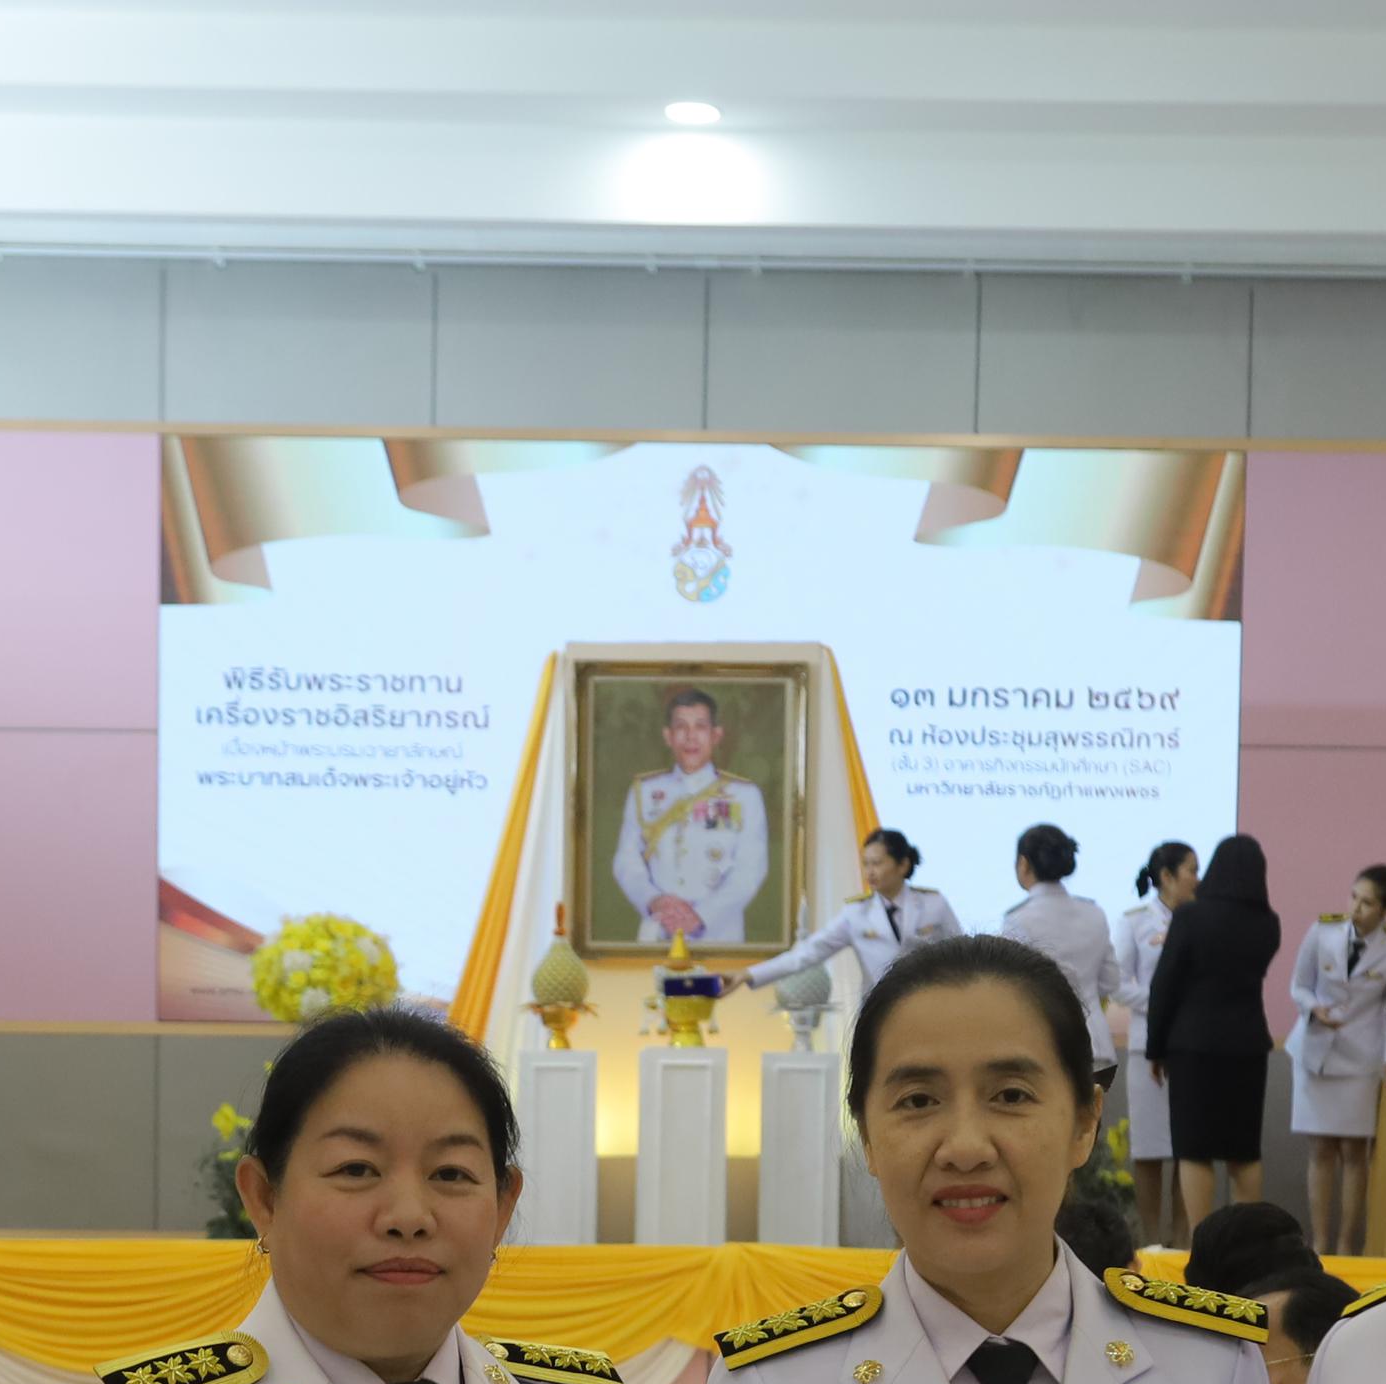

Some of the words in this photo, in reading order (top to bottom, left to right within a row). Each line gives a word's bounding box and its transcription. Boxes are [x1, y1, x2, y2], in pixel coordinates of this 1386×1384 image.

[222, 666, 463, 694] พิธีรับพระราชทาน
[195, 696, 491, 729] เครื่องราชอิสริยาภรณ์
[889, 687, 935, 709] ๑๓
[948, 686, 1074, 710] มกราคม
[889, 727, 912, 746] ณ
[921, 724, 1181, 753] ห้องประชุมสุพรรณิการ์
[196, 765, 489, 795] พระบาทสมเด็จพระเจ้าอยู่หัว
